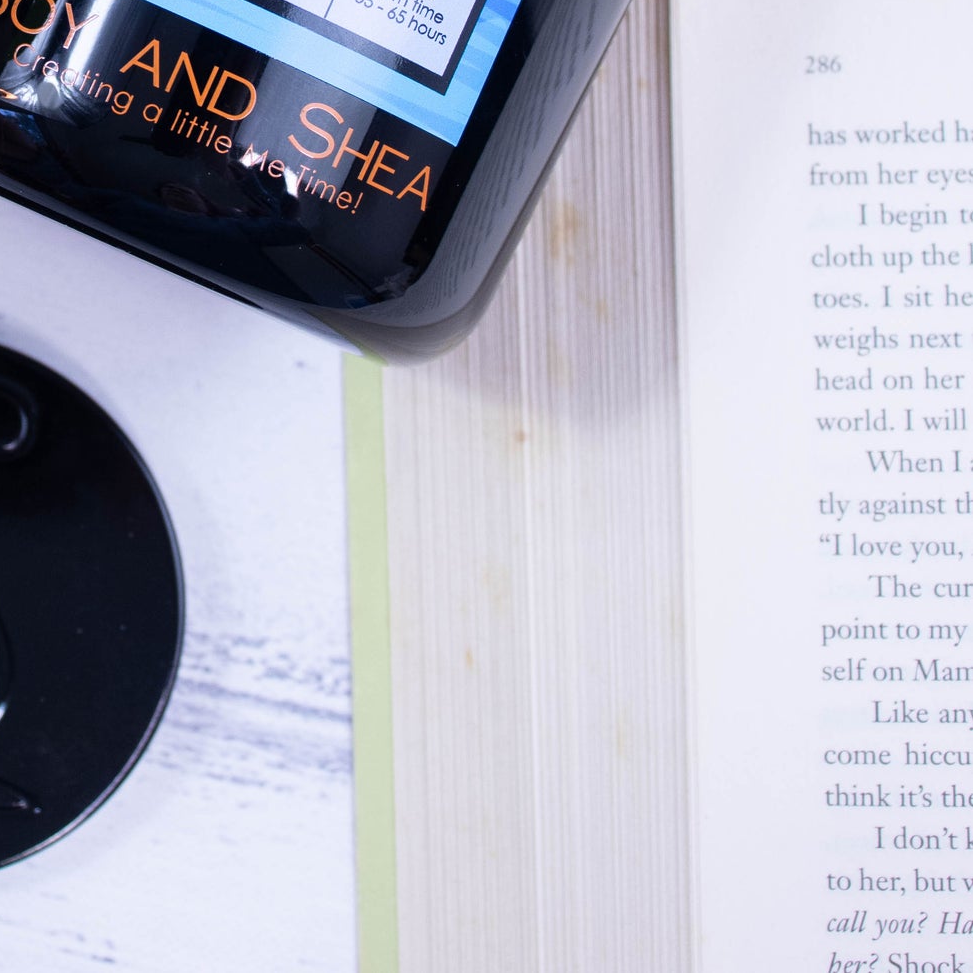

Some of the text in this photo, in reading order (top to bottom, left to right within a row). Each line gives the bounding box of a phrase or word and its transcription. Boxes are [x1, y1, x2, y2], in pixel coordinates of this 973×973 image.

[387, 7, 407, 24] 65
[407, 15, 447, 45] hours
[805, 55, 842, 74] 286
[13, 43, 364, 215] Creating a little Me Time!
[119, 38, 257, 121] AND
[288, 102, 431, 212] SHEA
[808, 123, 847, 145] has
[855, 120, 945, 144] worked
[809, 163, 868, 186] from
[877, 162, 919, 184] her
[859, 203, 867, 226] I
[880, 203, 948, 232] begin
[812, 244, 872, 268] cloth
[882, 251, 913, 273] up
[922, 243, 960, 267] the
[813, 292, 869, 308] toes.
[883, 285, 891, 307] I
[904, 285, 933, 308] sit
[814, 326, 898, 356] weighs
[910, 332, 962, 348] next
[815, 366, 965, 390] head on her
[816, 408, 967, 431] world. I will
[866, 450, 944, 473] When
[953, 450, 962, 472] I
[819, 492, 850, 521] tly
[859, 493, 946, 522] against
[852, 533, 902, 557] love
[911, 540, 964, 564] you,
[868, 574, 922, 598] The
[821, 617, 968, 647] point to my
[822, 658, 867, 682] self
[872, 665, 904, 682] on
[872, 700, 929, 723] Like
[824, 749, 892, 765] come
[825, 783, 892, 807] think
[875, 826, 885, 849] I
[827, 874, 852, 891] to
[859, 868, 906, 896] her,
[914, 868, 956, 892] but
[827, 910, 867, 933] call
[872, 911, 928, 941] you?
